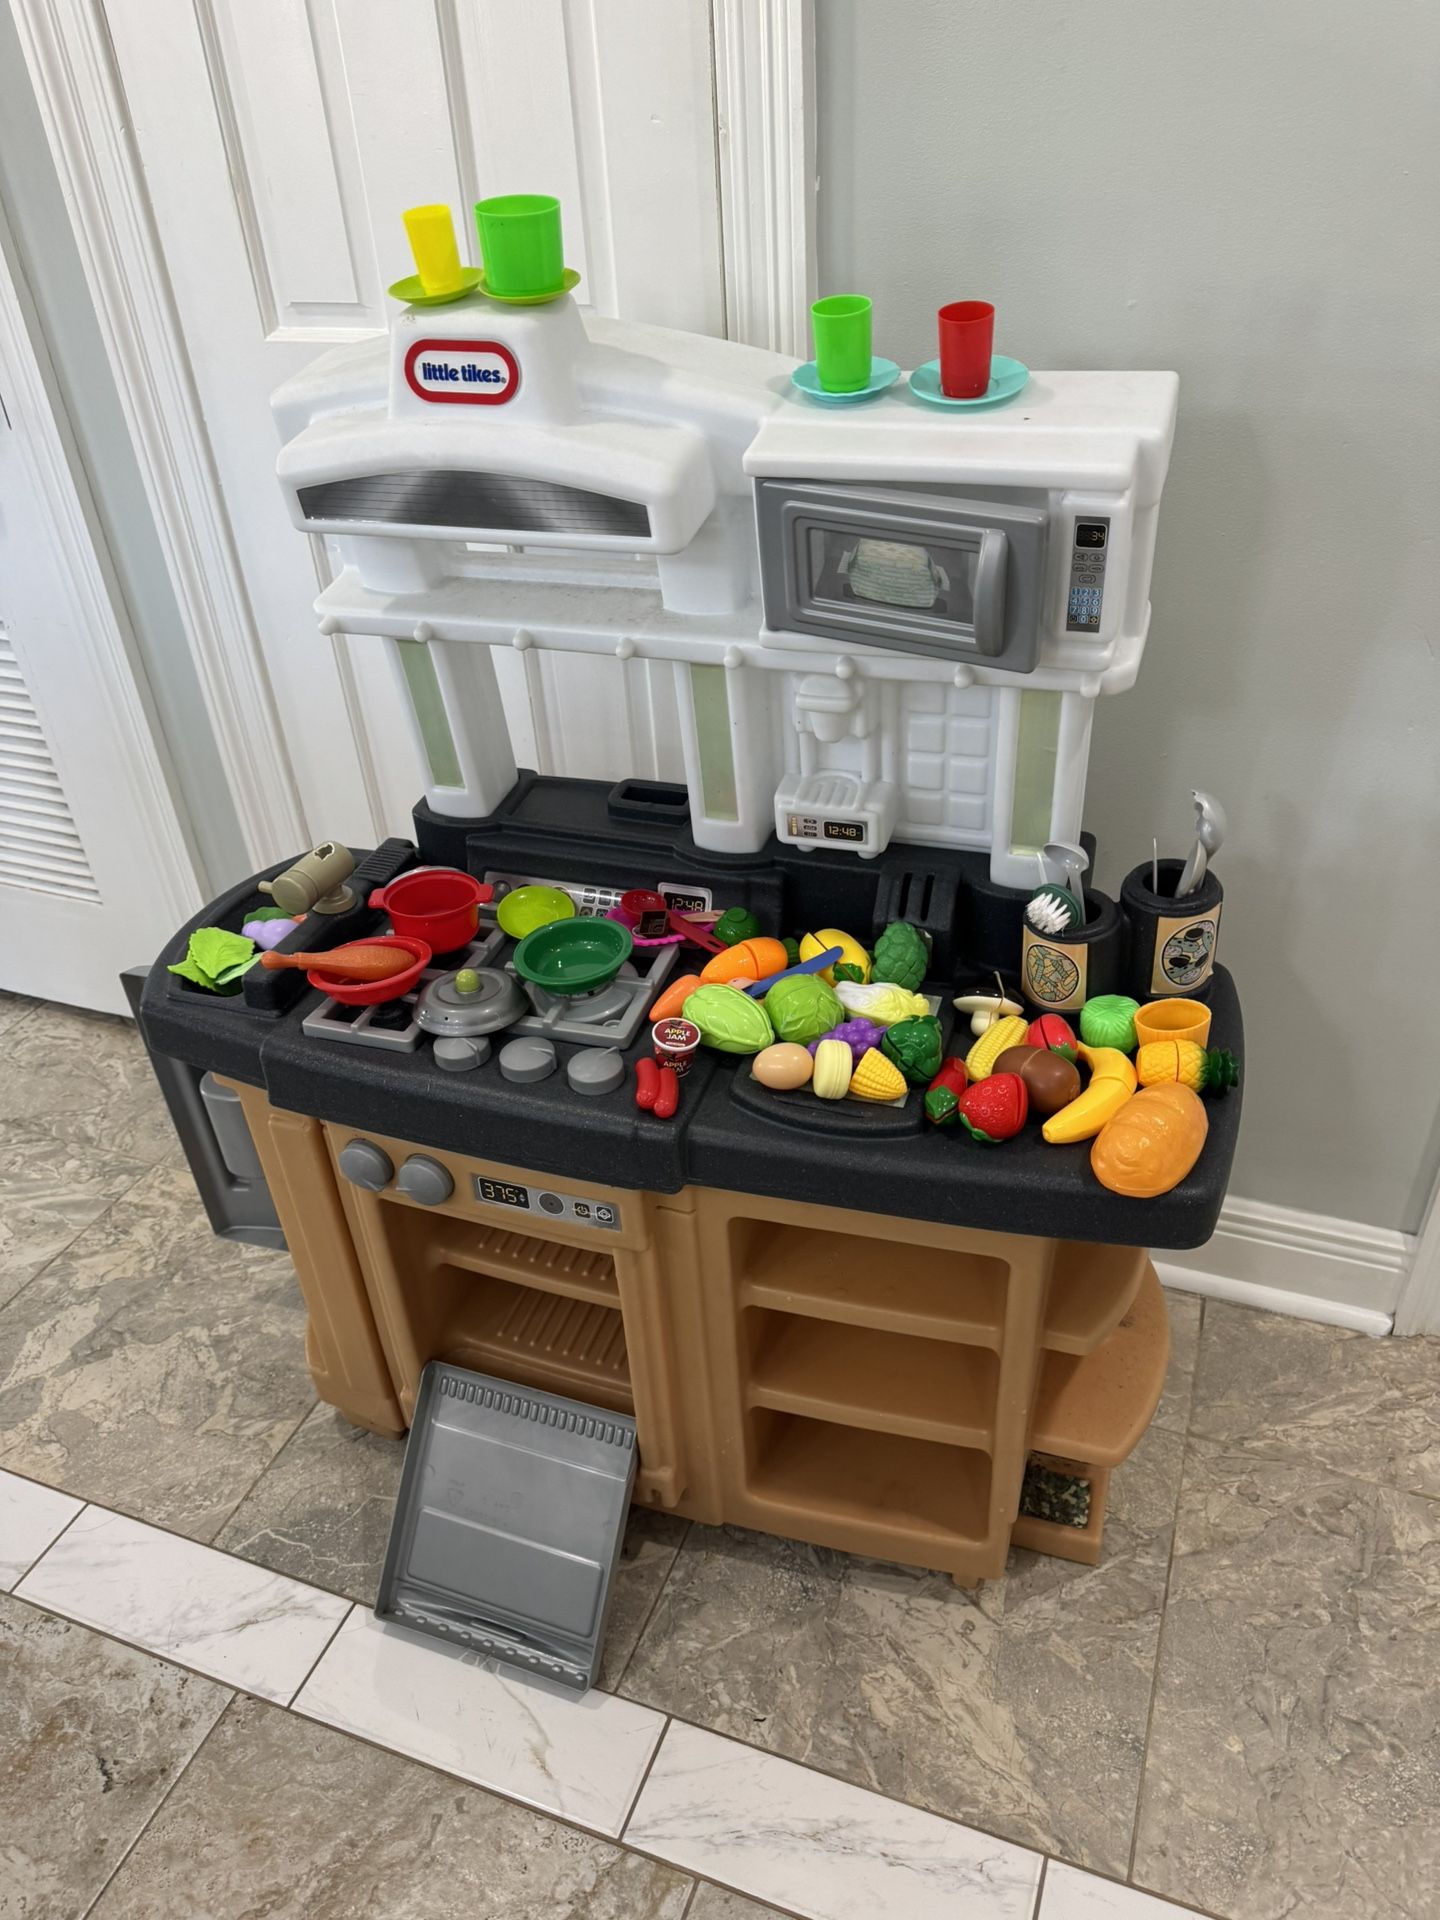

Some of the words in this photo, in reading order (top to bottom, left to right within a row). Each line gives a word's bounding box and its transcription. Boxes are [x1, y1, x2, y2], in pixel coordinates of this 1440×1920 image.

[422, 362, 459, 382] little
[828, 825, 857, 837] 12:48
[664, 1028, 691, 1037] APPLE
[663, 1060, 687, 1068] APPLE
